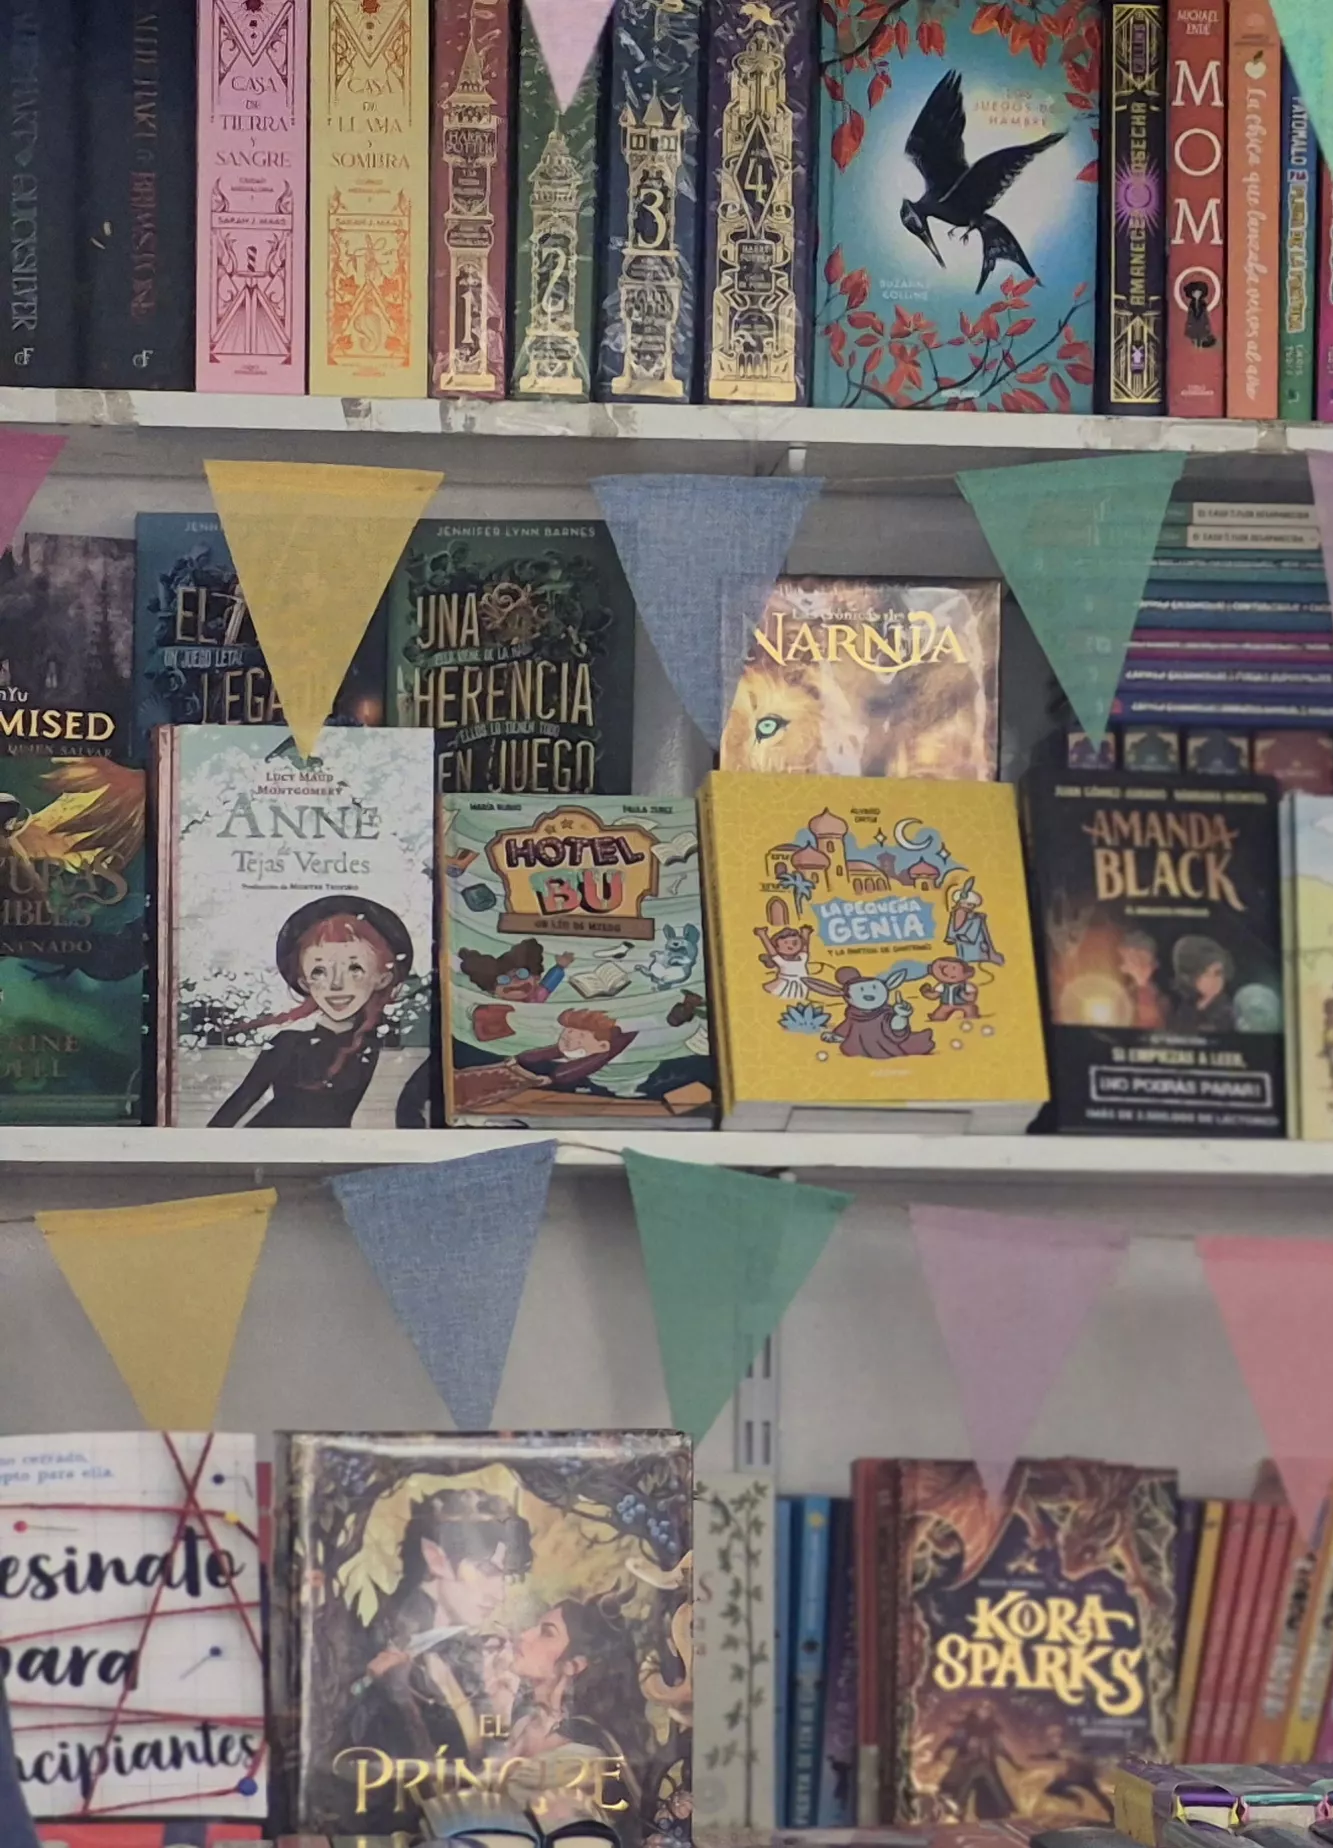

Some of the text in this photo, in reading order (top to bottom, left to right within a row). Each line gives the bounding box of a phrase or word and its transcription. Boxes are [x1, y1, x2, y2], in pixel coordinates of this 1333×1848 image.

[215, 151, 291, 168] SANGRE
[745, 156, 767, 203] 4
[638, 188, 667, 248] 3
[505, 528, 539, 537] LYNN
[544, 527, 595, 538] BARNES
[754, 611, 969, 673] NARNIA
[203, 668, 284, 725] LEGA
[413, 659, 594, 729] HERENCIA
[0, 709, 116, 741] MISED
[266, 772, 333, 783] LUCY MAUD
[438, 738, 595, 794] EN JUEGO
[257, 785, 343, 796] MONTGOMERY
[216, 792, 380, 840] ANNE
[1082, 809, 1240, 850] AMANDA
[231, 850, 371, 881] Tejas Verdes
[505, 835, 646, 868] HOTEL
[529, 868, 625, 915] BU
[1093, 848, 1245, 912] BLACK
[820, 902, 841, 918] LA
[0, 1526, 246, 1600] esinato
[965, 1590, 1135, 1648] KORA
[933, 1633, 1144, 1716] SPARKS
[479, 1714, 509, 1737] EL
